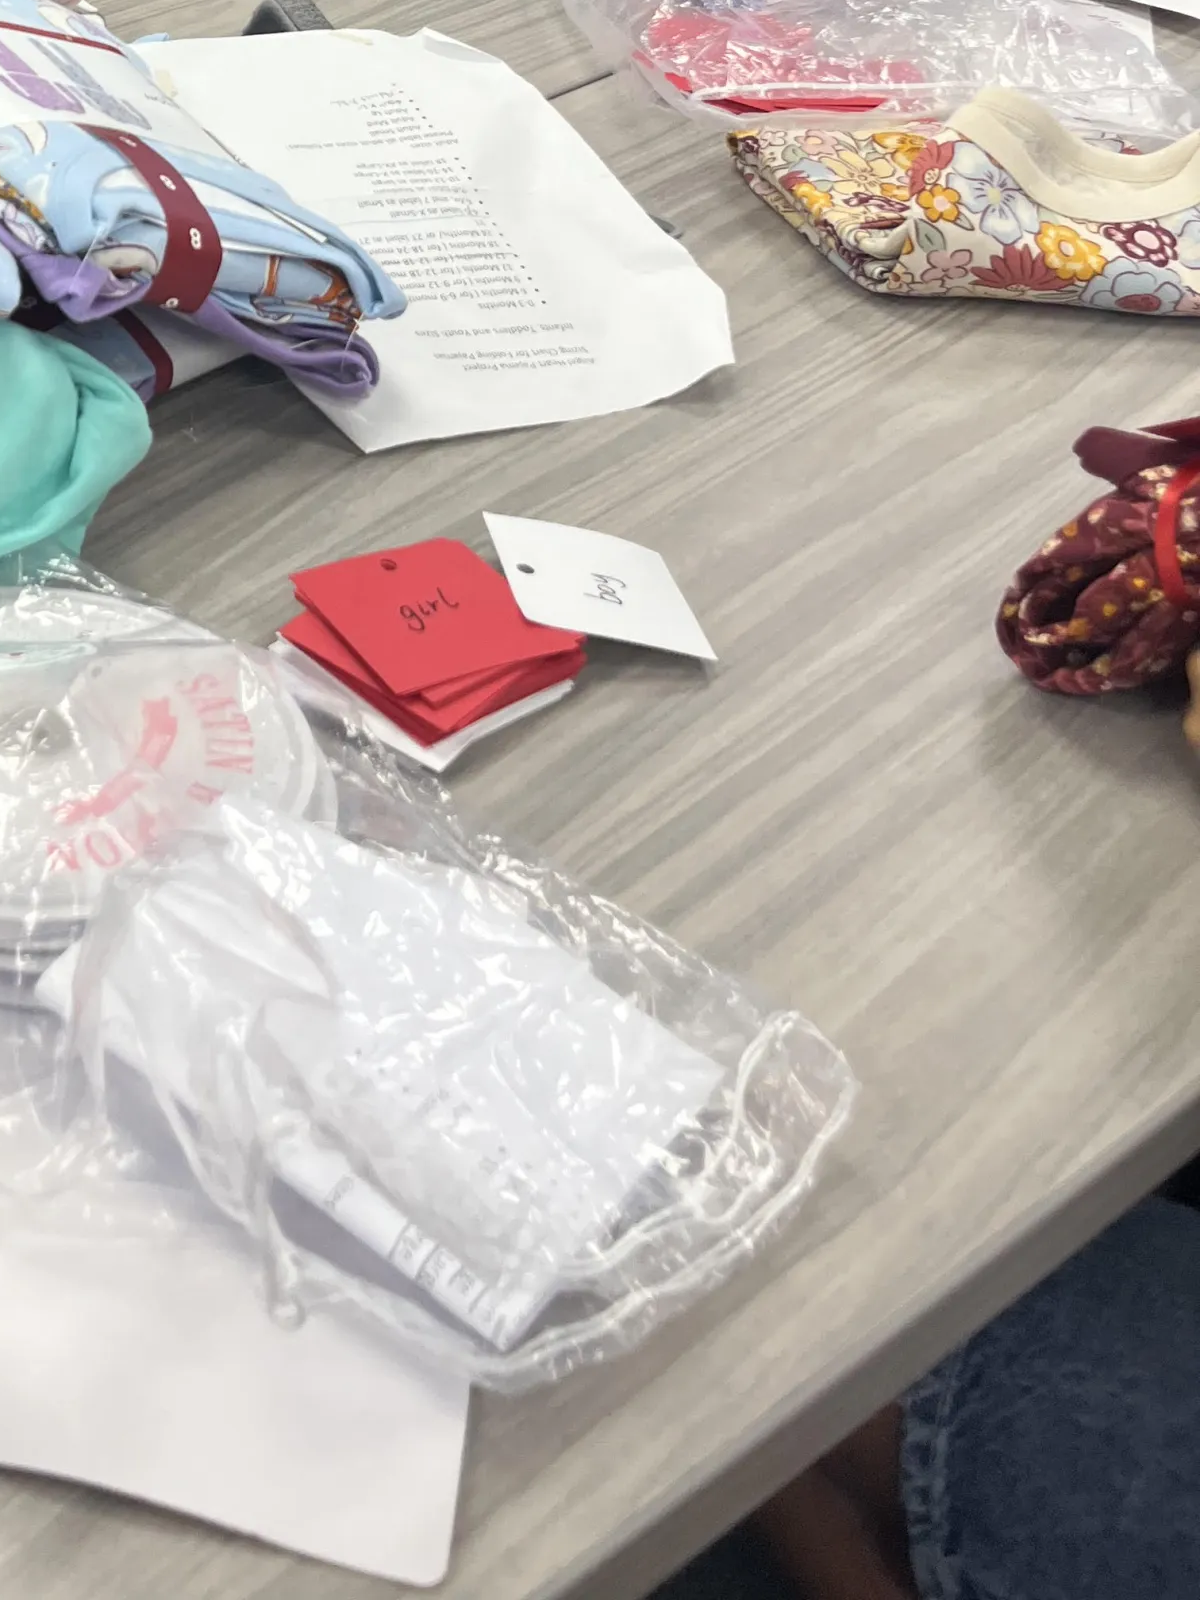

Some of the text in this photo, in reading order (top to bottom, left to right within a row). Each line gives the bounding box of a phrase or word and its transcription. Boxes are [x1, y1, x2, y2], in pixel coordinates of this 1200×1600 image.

[399, 134, 422, 142] label
[357, 200, 384, 209] Small
[399, 197, 423, 206] label
[389, 210, 426, 219] X-Small
[189, 227, 202, 251] 8
[385, 234, 409, 243] label
[396, 245, 424, 254] 18-24
[427, 244, 441, 252] for
[449, 241, 486, 251] Months
[402, 257, 430, 266] 12-18
[434, 256, 448, 264] for
[409, 268, 437, 279] 12-18
[440, 267, 455, 276] for
[461, 265, 500, 275] Months
[428, 280, 451, 289] 9-12
[454, 278, 468, 287] for
[475, 276, 513, 286] Months
[439, 292, 457, 302] 6-9
[460, 290, 474, 299] for
[481, 287, 519, 298] Months
[478, 300, 518, 311] Months
[441, 328, 471, 338] Youth
[472, 327, 492, 336] and
[493, 324, 538, 335] Toddlers
[515, 350, 530, 359] for
[531, 348, 558, 357] Chart
[462, 362, 499, 373] Project
[583, 572, 627, 605] boy
[399, 586, 461, 632] girl
